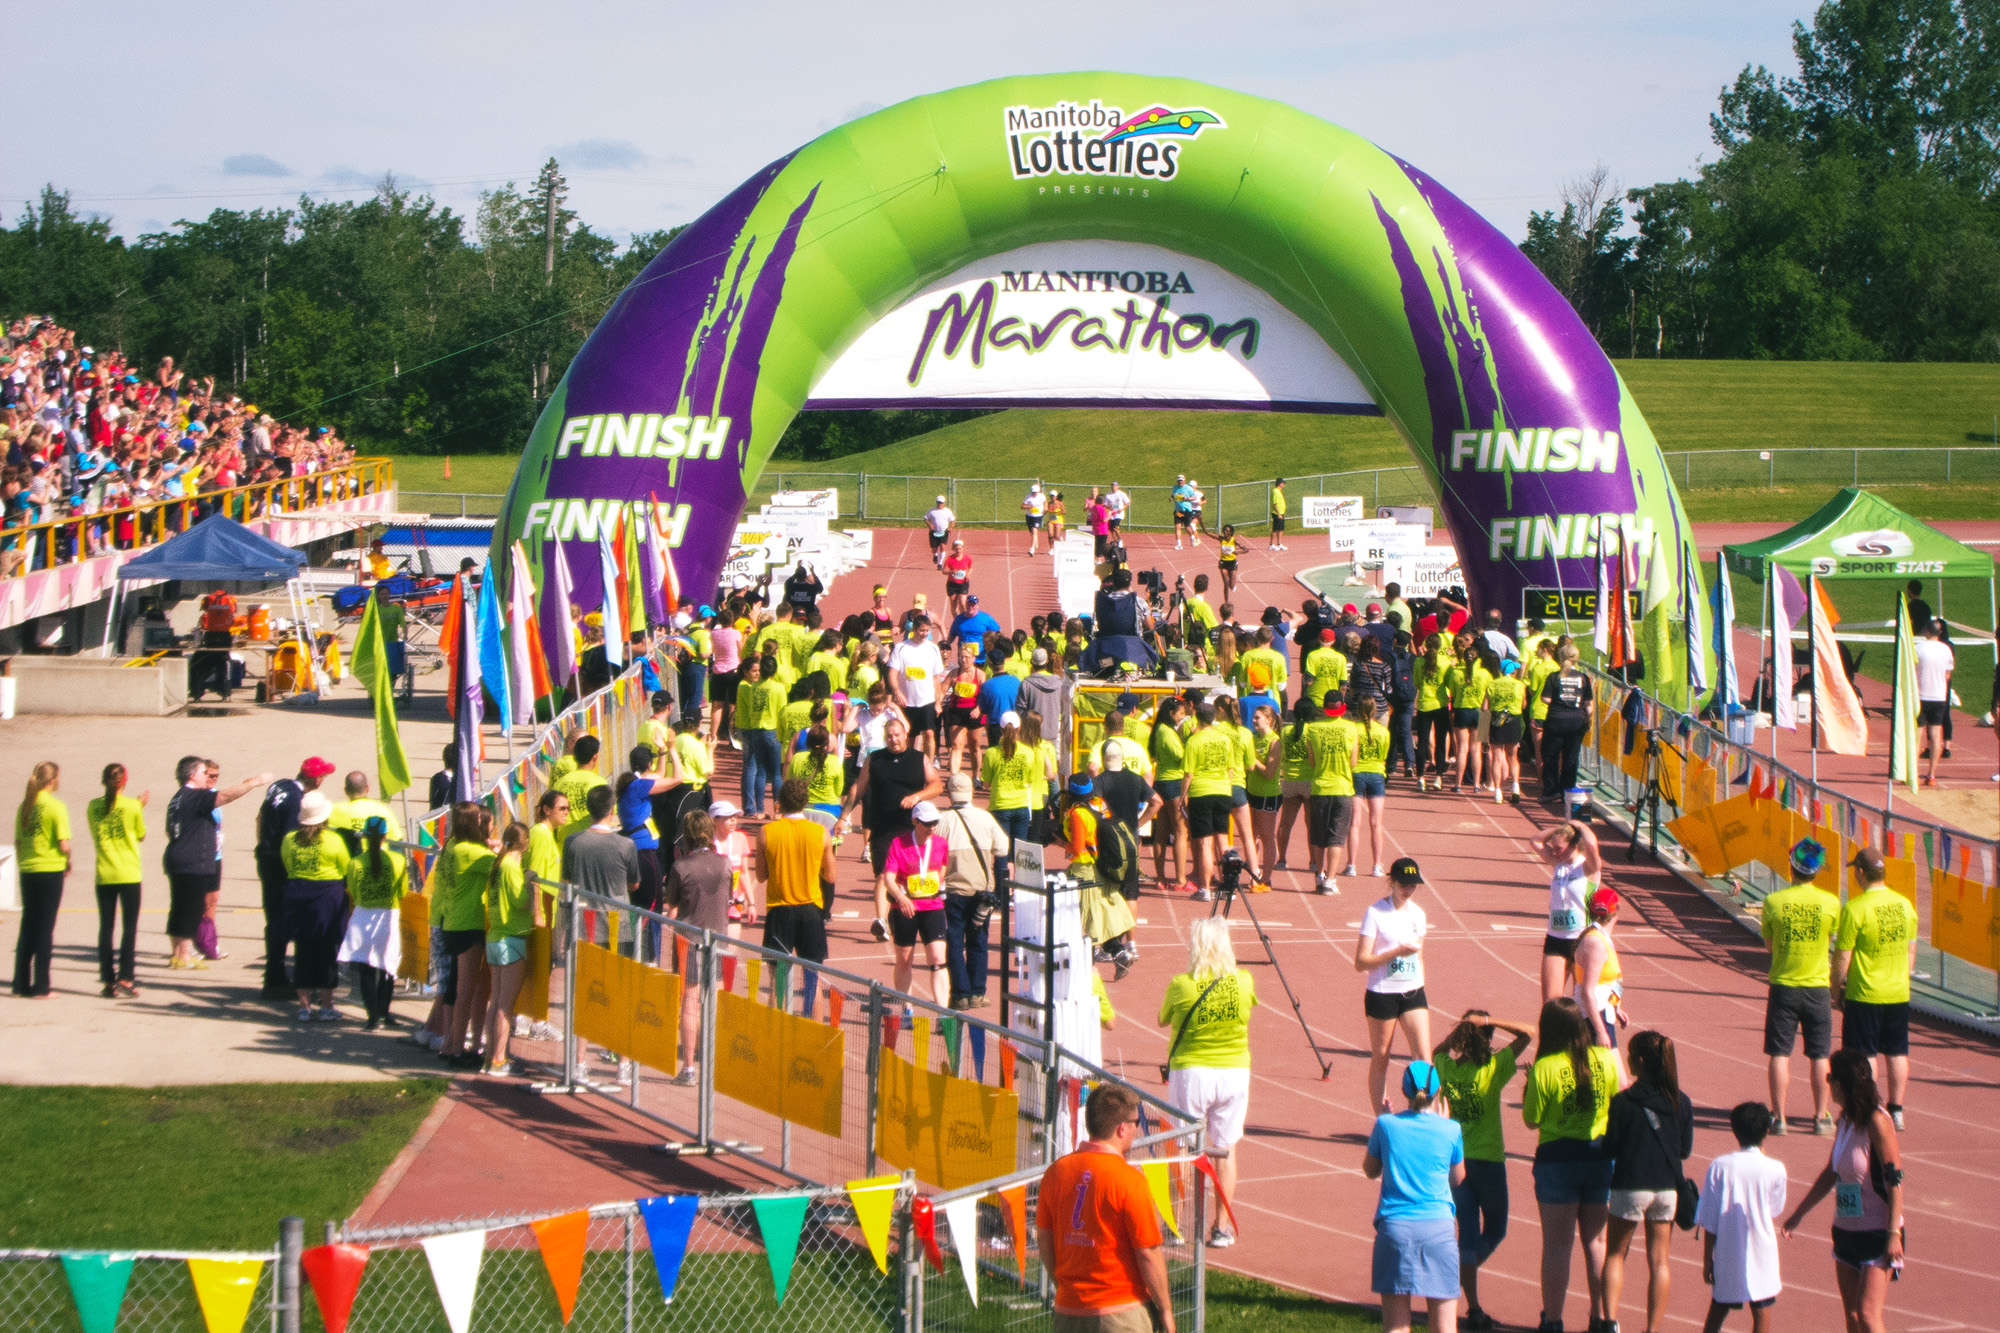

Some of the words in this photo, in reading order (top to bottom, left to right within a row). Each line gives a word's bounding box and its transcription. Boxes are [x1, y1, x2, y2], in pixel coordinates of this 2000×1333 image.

[1008, 103, 1121, 131] Manitoba
[1010, 131, 1178, 178] Lotteries
[1039, 185, 1149, 198] PRESENTS
[1002, 271, 1194, 294] MANITOBA
[906, 279, 1261, 387] Marathon
[556, 414, 731, 460] FINISH
[1451, 428, 1619, 473] FINISH
[1313, 507, 1352, 517] Lotteries
[1490, 513, 1653, 561] FINISH
[1415, 561, 1449, 570] Manitoba
[1840, 561, 1944, 574] SPORTSTATS
[1406, 585, 1427, 594] FULL
[1553, 915, 1576, 926] 8811
